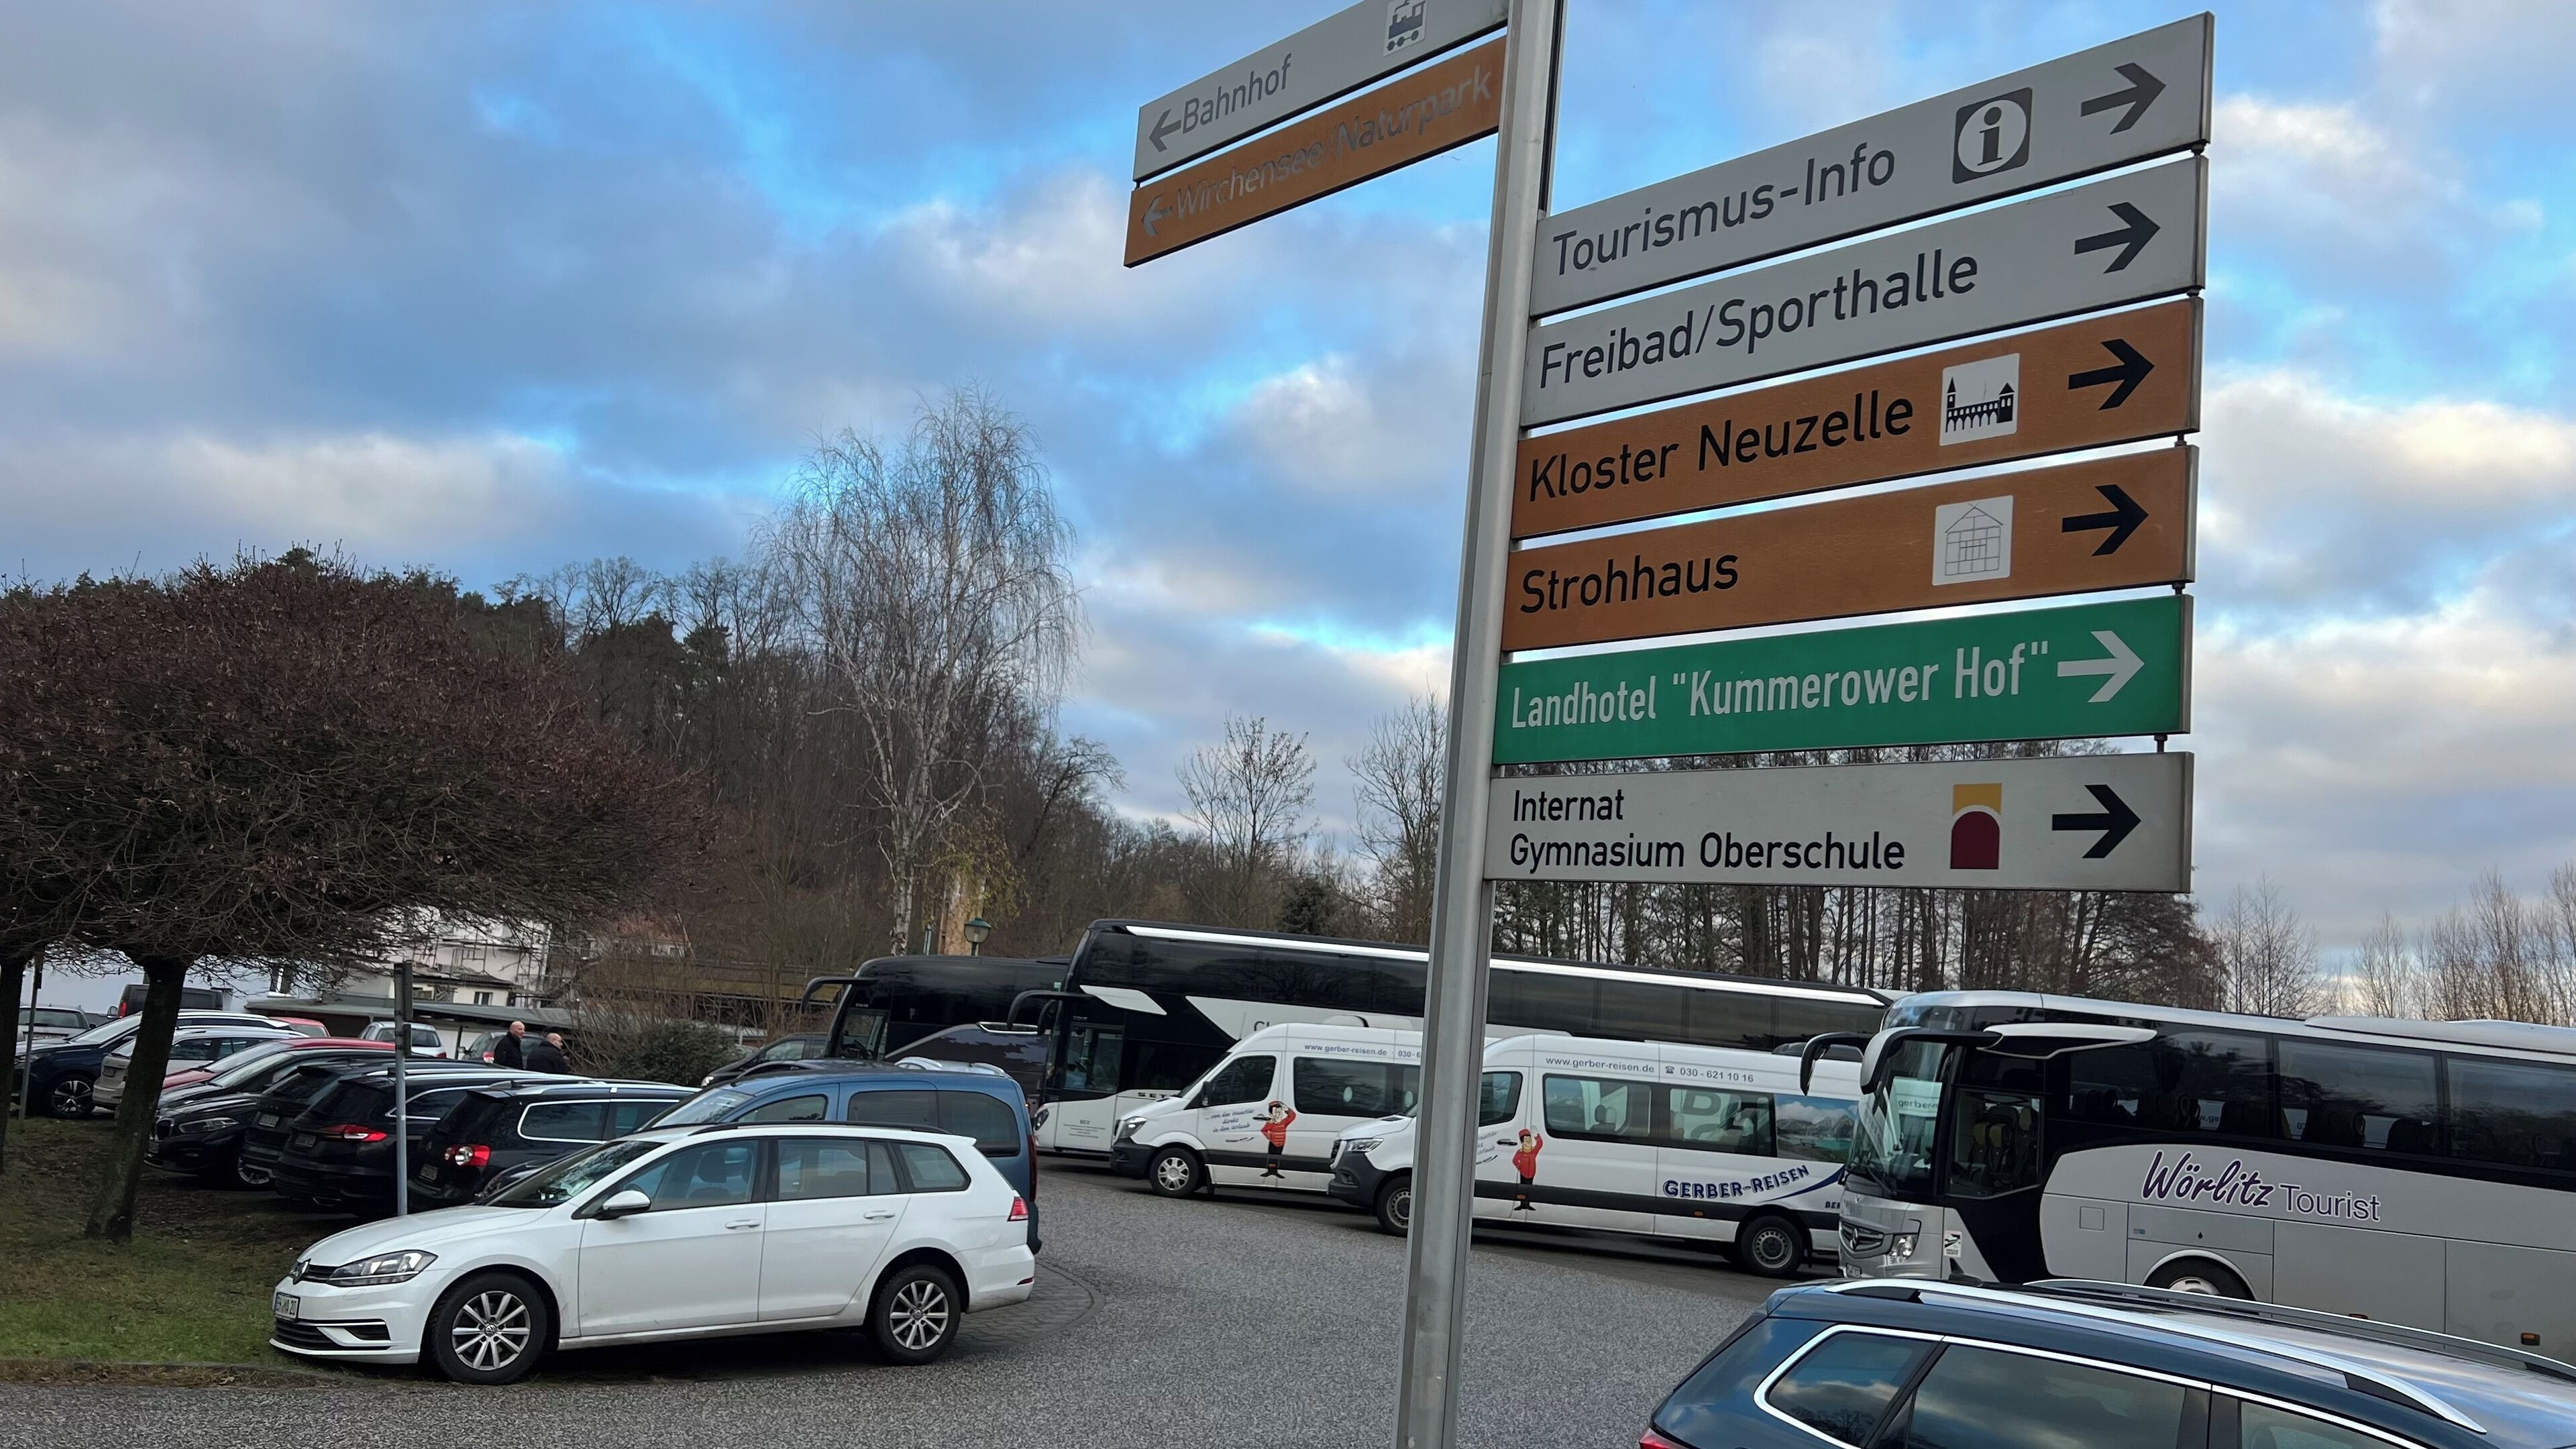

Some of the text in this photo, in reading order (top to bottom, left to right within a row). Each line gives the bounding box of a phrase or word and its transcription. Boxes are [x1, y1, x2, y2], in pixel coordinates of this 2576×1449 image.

[1183, 53, 1292, 134] Bahnhof
[1553, 142, 1894, 276] Tourismus-Info
[1540, 249, 1978, 388] Freibad/Sporthalle
[1529, 390, 1913, 502] Kloster Neuzelle
[1521, 553, 1739, 614] Strohhaus
[1511, 640, 2049, 729] Landhotel "Kummerower Hof"
[1513, 789, 1624, 822] Internat
[1510, 831, 1905, 875] Gymnasium Oberschule
[1546, 1057, 1654, 1073] www.gerber-reisen.de
[1680, 1067, 1698, 1077] 030
[1706, 1070, 1723, 1079] 621
[1728, 1073, 1739, 1081] 10
[1742, 1074, 1754, 1082] 16
[1662, 1165, 1810, 1199] GERBER-REISEN
[2142, 1150, 2381, 1222] Wörlitz Tourist
